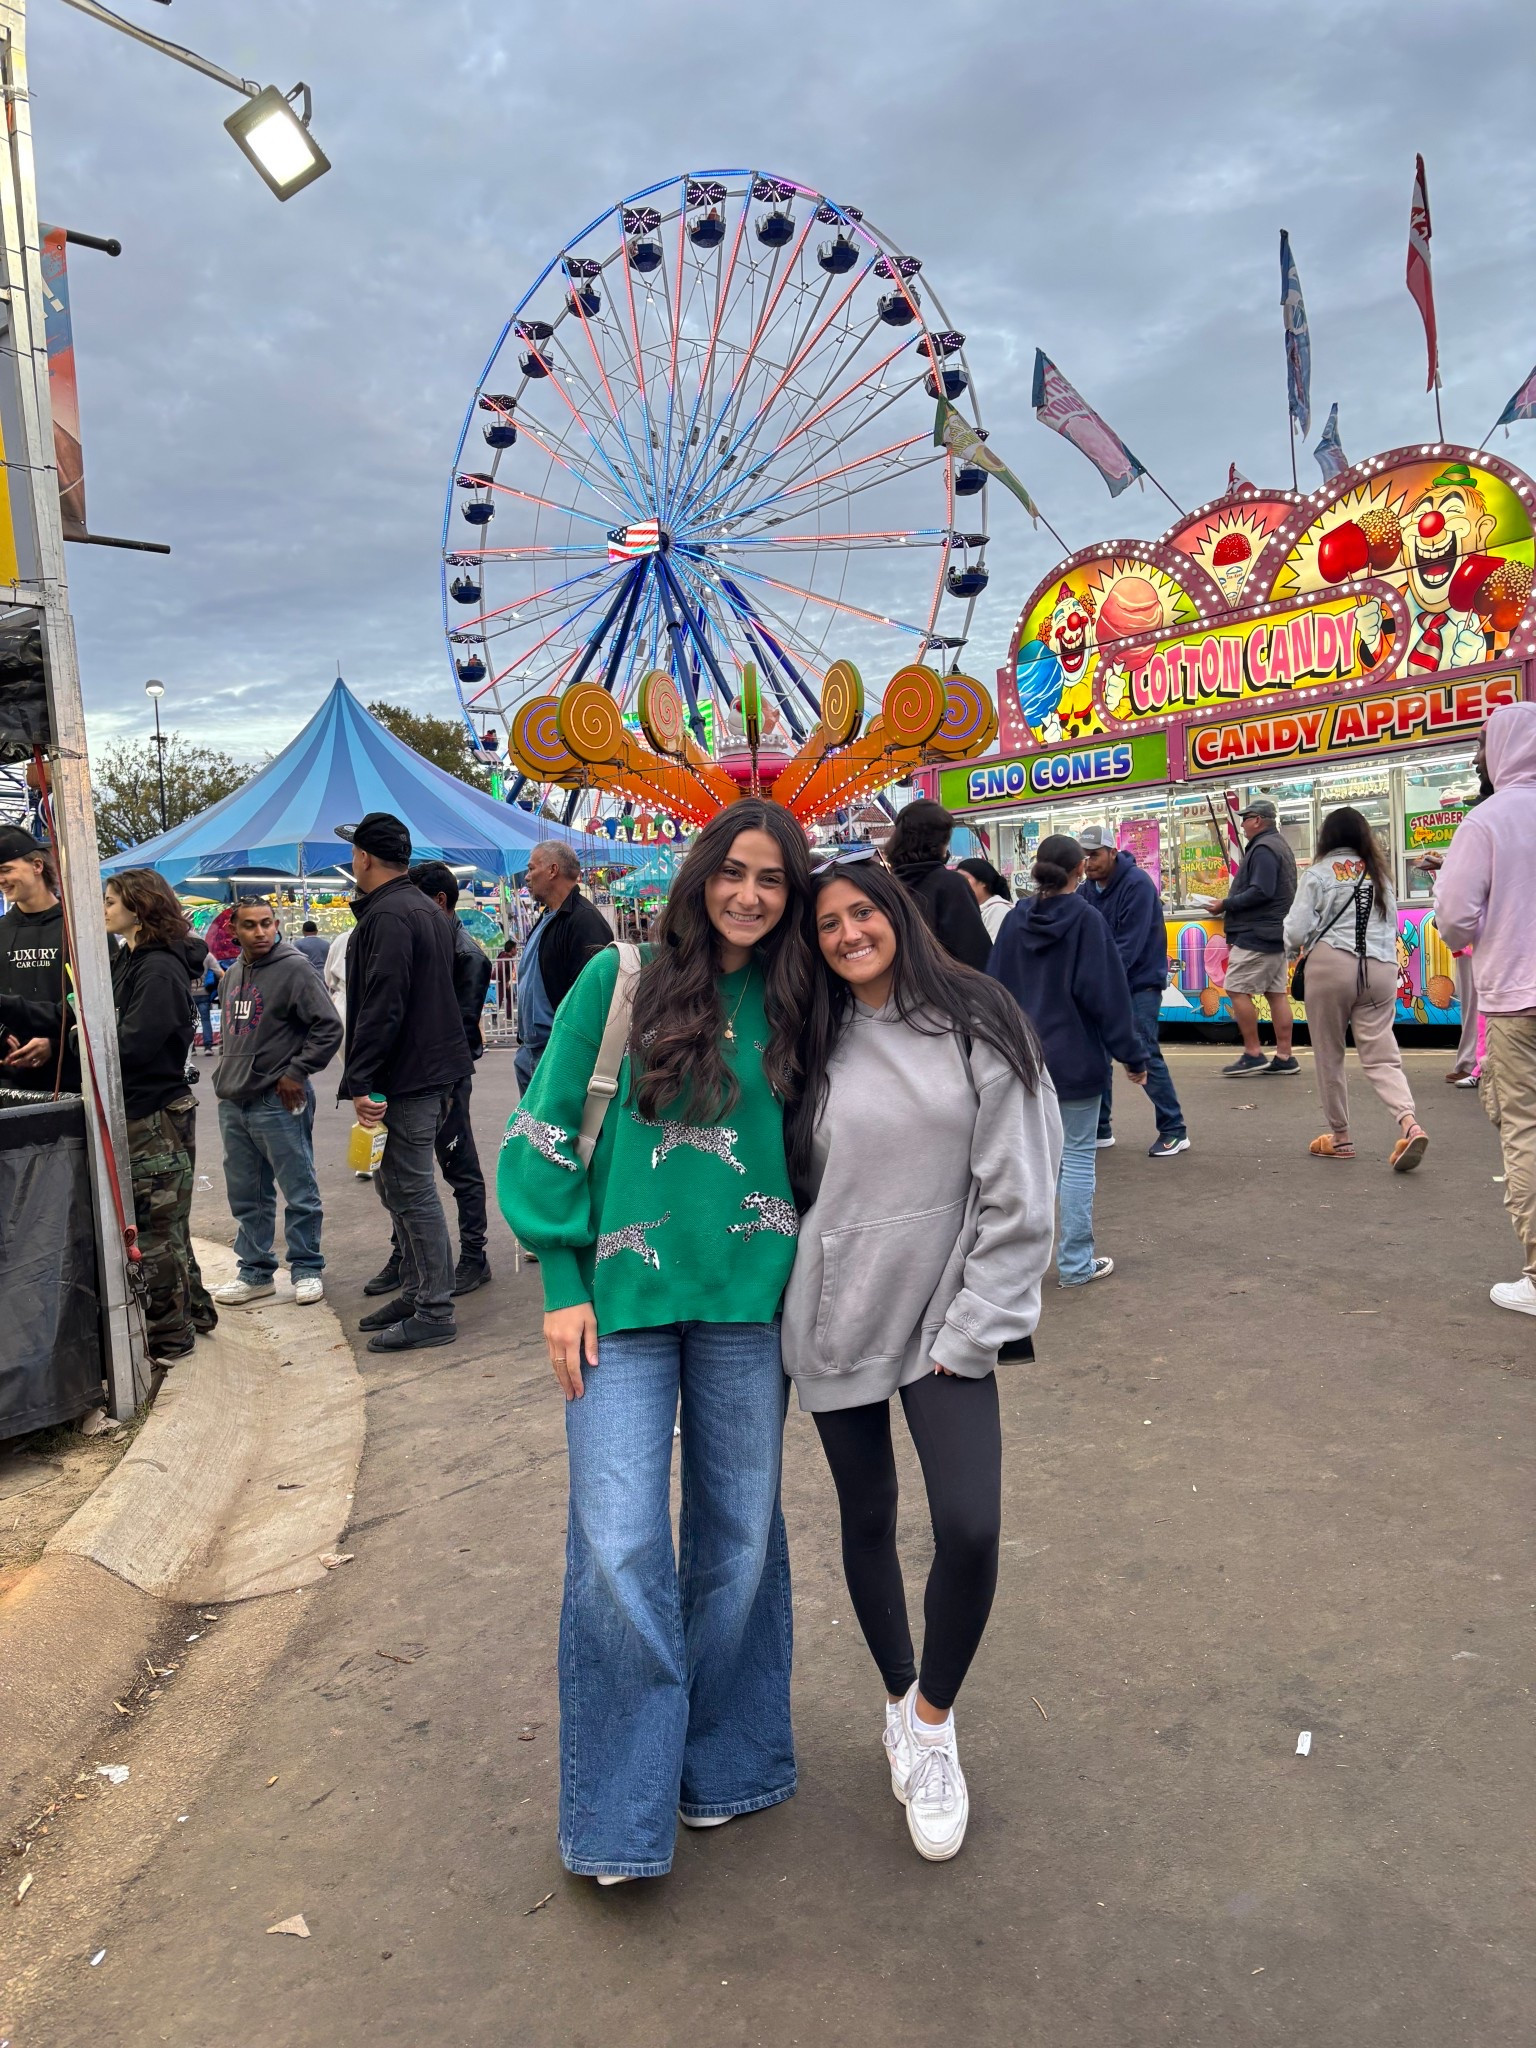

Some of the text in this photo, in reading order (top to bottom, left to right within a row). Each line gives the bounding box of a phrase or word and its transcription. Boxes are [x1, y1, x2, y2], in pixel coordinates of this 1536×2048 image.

[1131, 608, 1358, 711] COTTON CANDY
[1195, 676, 1517, 766] CANDY APPLES
[969, 762, 1026, 800] SNO
[1031, 744, 1133, 791] CONES
[1410, 829, 1453, 849] LON
[1180, 859, 1222, 873] SHAKE-UPS
[7, 948, 58, 962] LUXURY
[16, 961, 31, 969] CAR
